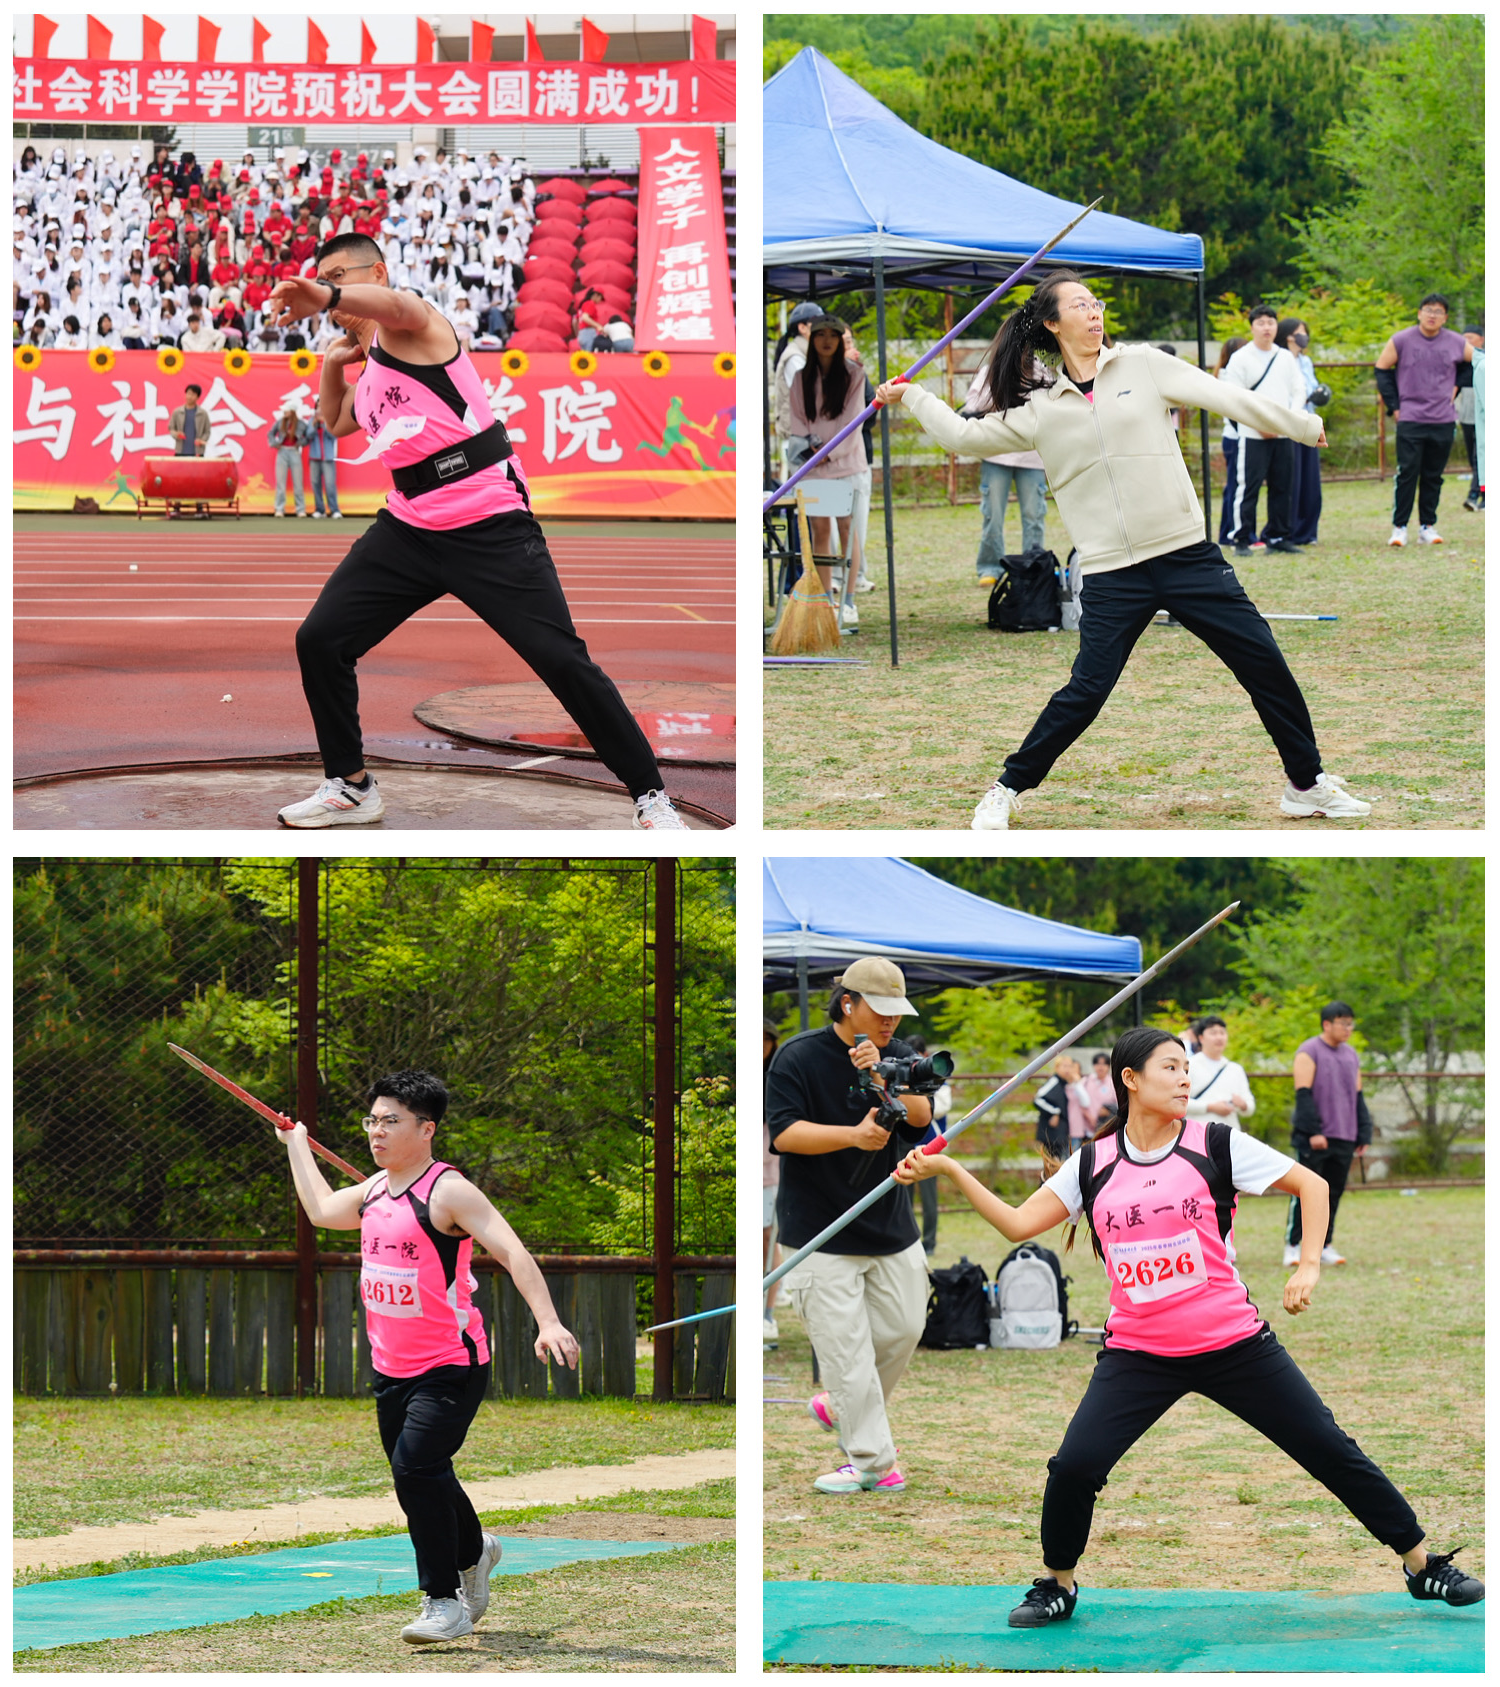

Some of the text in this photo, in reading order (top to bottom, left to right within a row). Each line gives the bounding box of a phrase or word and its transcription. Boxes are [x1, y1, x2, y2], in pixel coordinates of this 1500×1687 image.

[653, 138, 715, 341] 人文学子 再创辉煌
[1105, 1197, 1203, 1234] 大医一院
[1117, 1252, 1195, 1289] 2626
[364, 1278, 415, 1306] 2612
